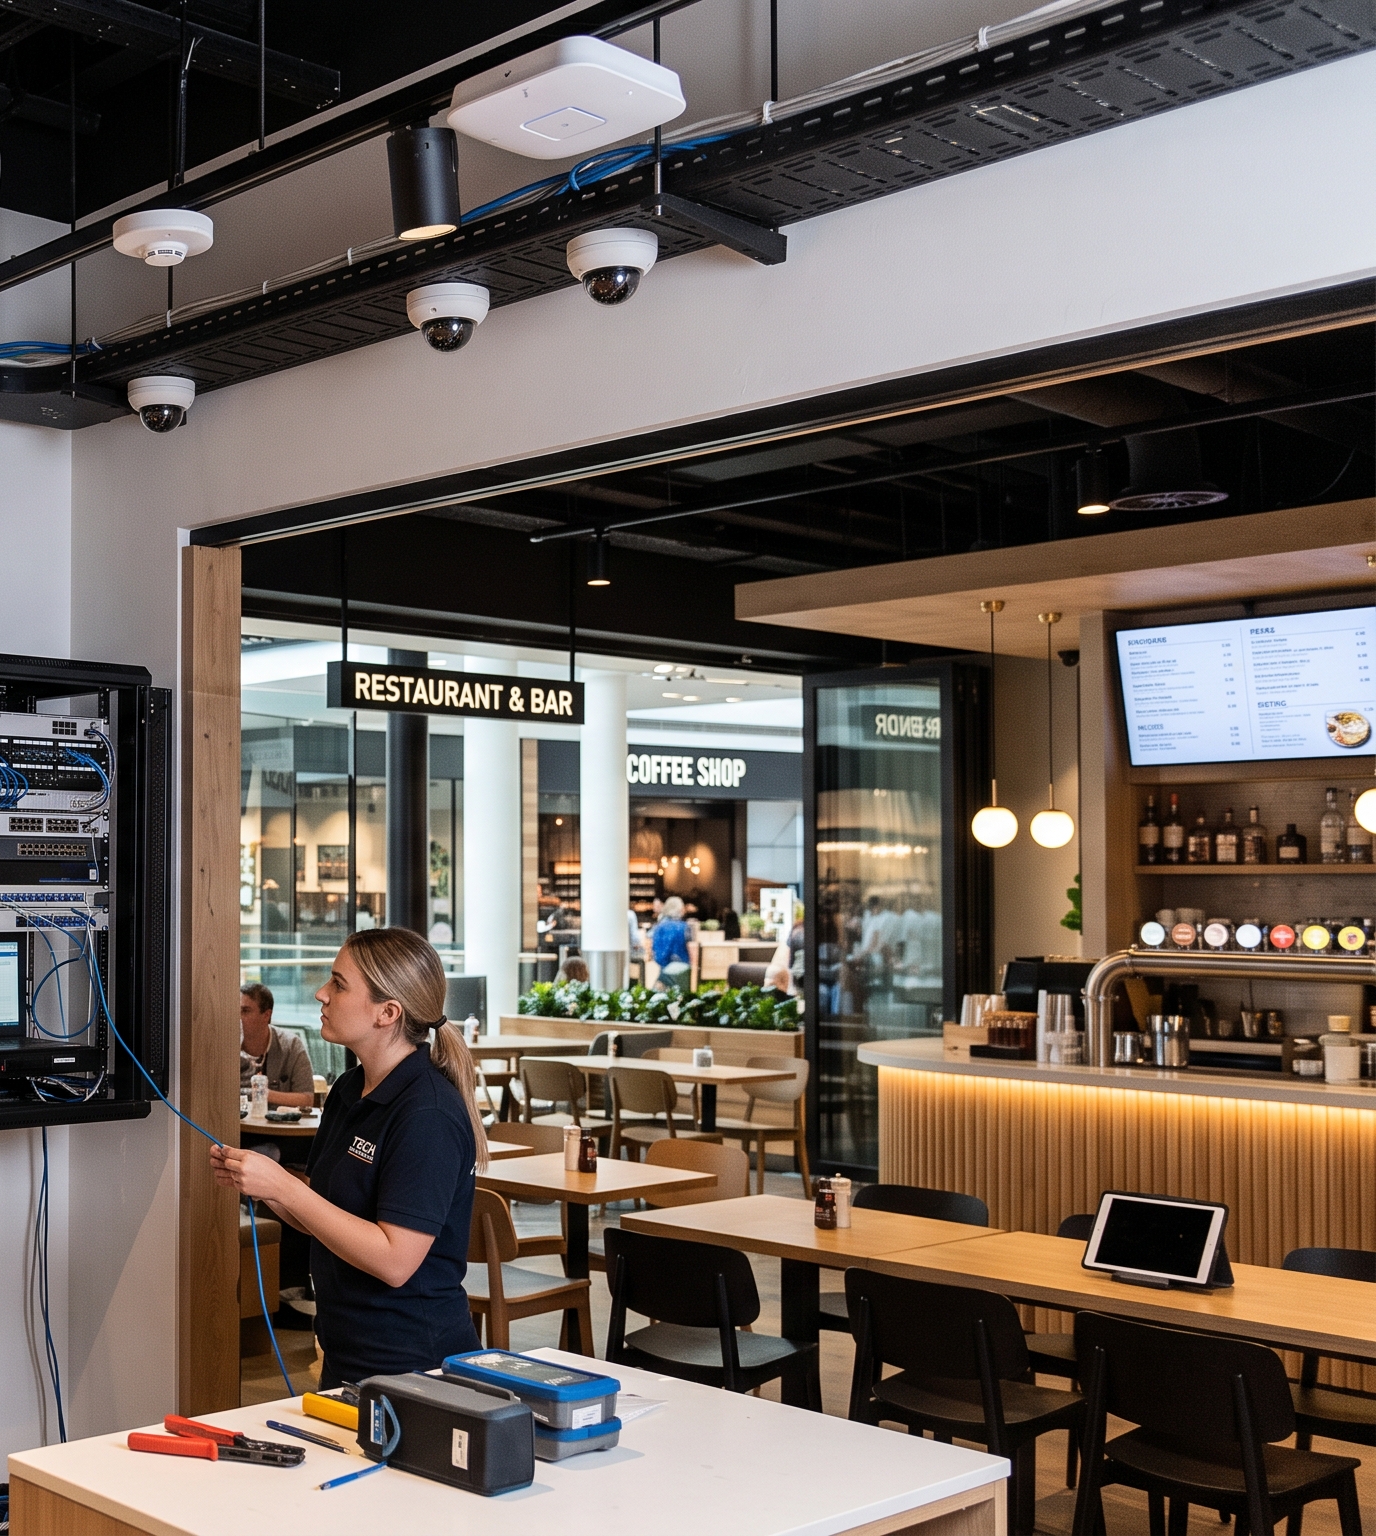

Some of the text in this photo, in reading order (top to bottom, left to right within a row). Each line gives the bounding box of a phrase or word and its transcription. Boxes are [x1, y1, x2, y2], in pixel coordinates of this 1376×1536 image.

[354, 671, 574, 717] RESTAURANT & BAR
[626, 753, 747, 788] COFFEE SHOP
[352, 1136, 376, 1156] TECH
